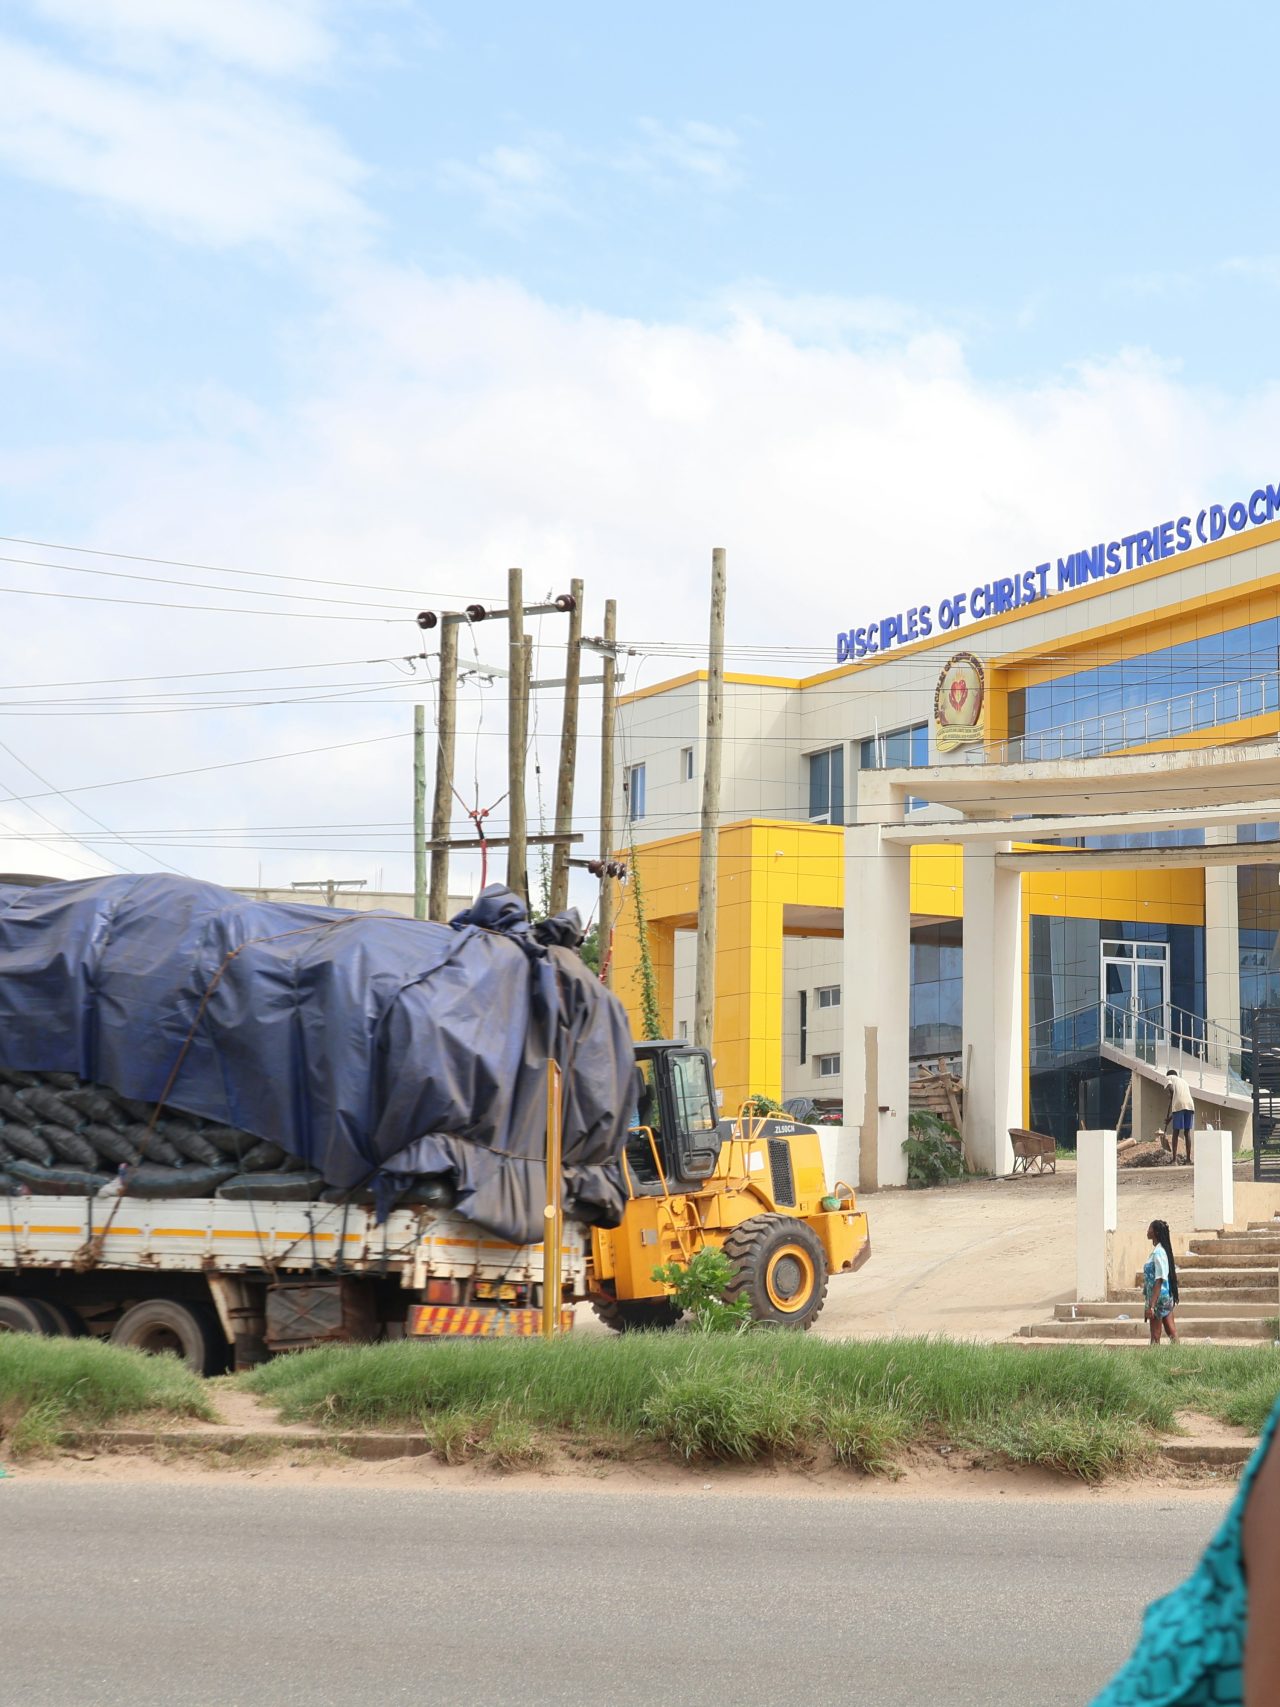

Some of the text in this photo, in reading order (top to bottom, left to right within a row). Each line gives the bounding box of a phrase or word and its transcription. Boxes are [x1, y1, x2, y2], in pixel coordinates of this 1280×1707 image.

[836, 605, 933, 663] DISCIPLES
[937, 593, 967, 630] OF
[970, 562, 1052, 619] CHRIST
[1056, 515, 1192, 592] MINISTRIES
